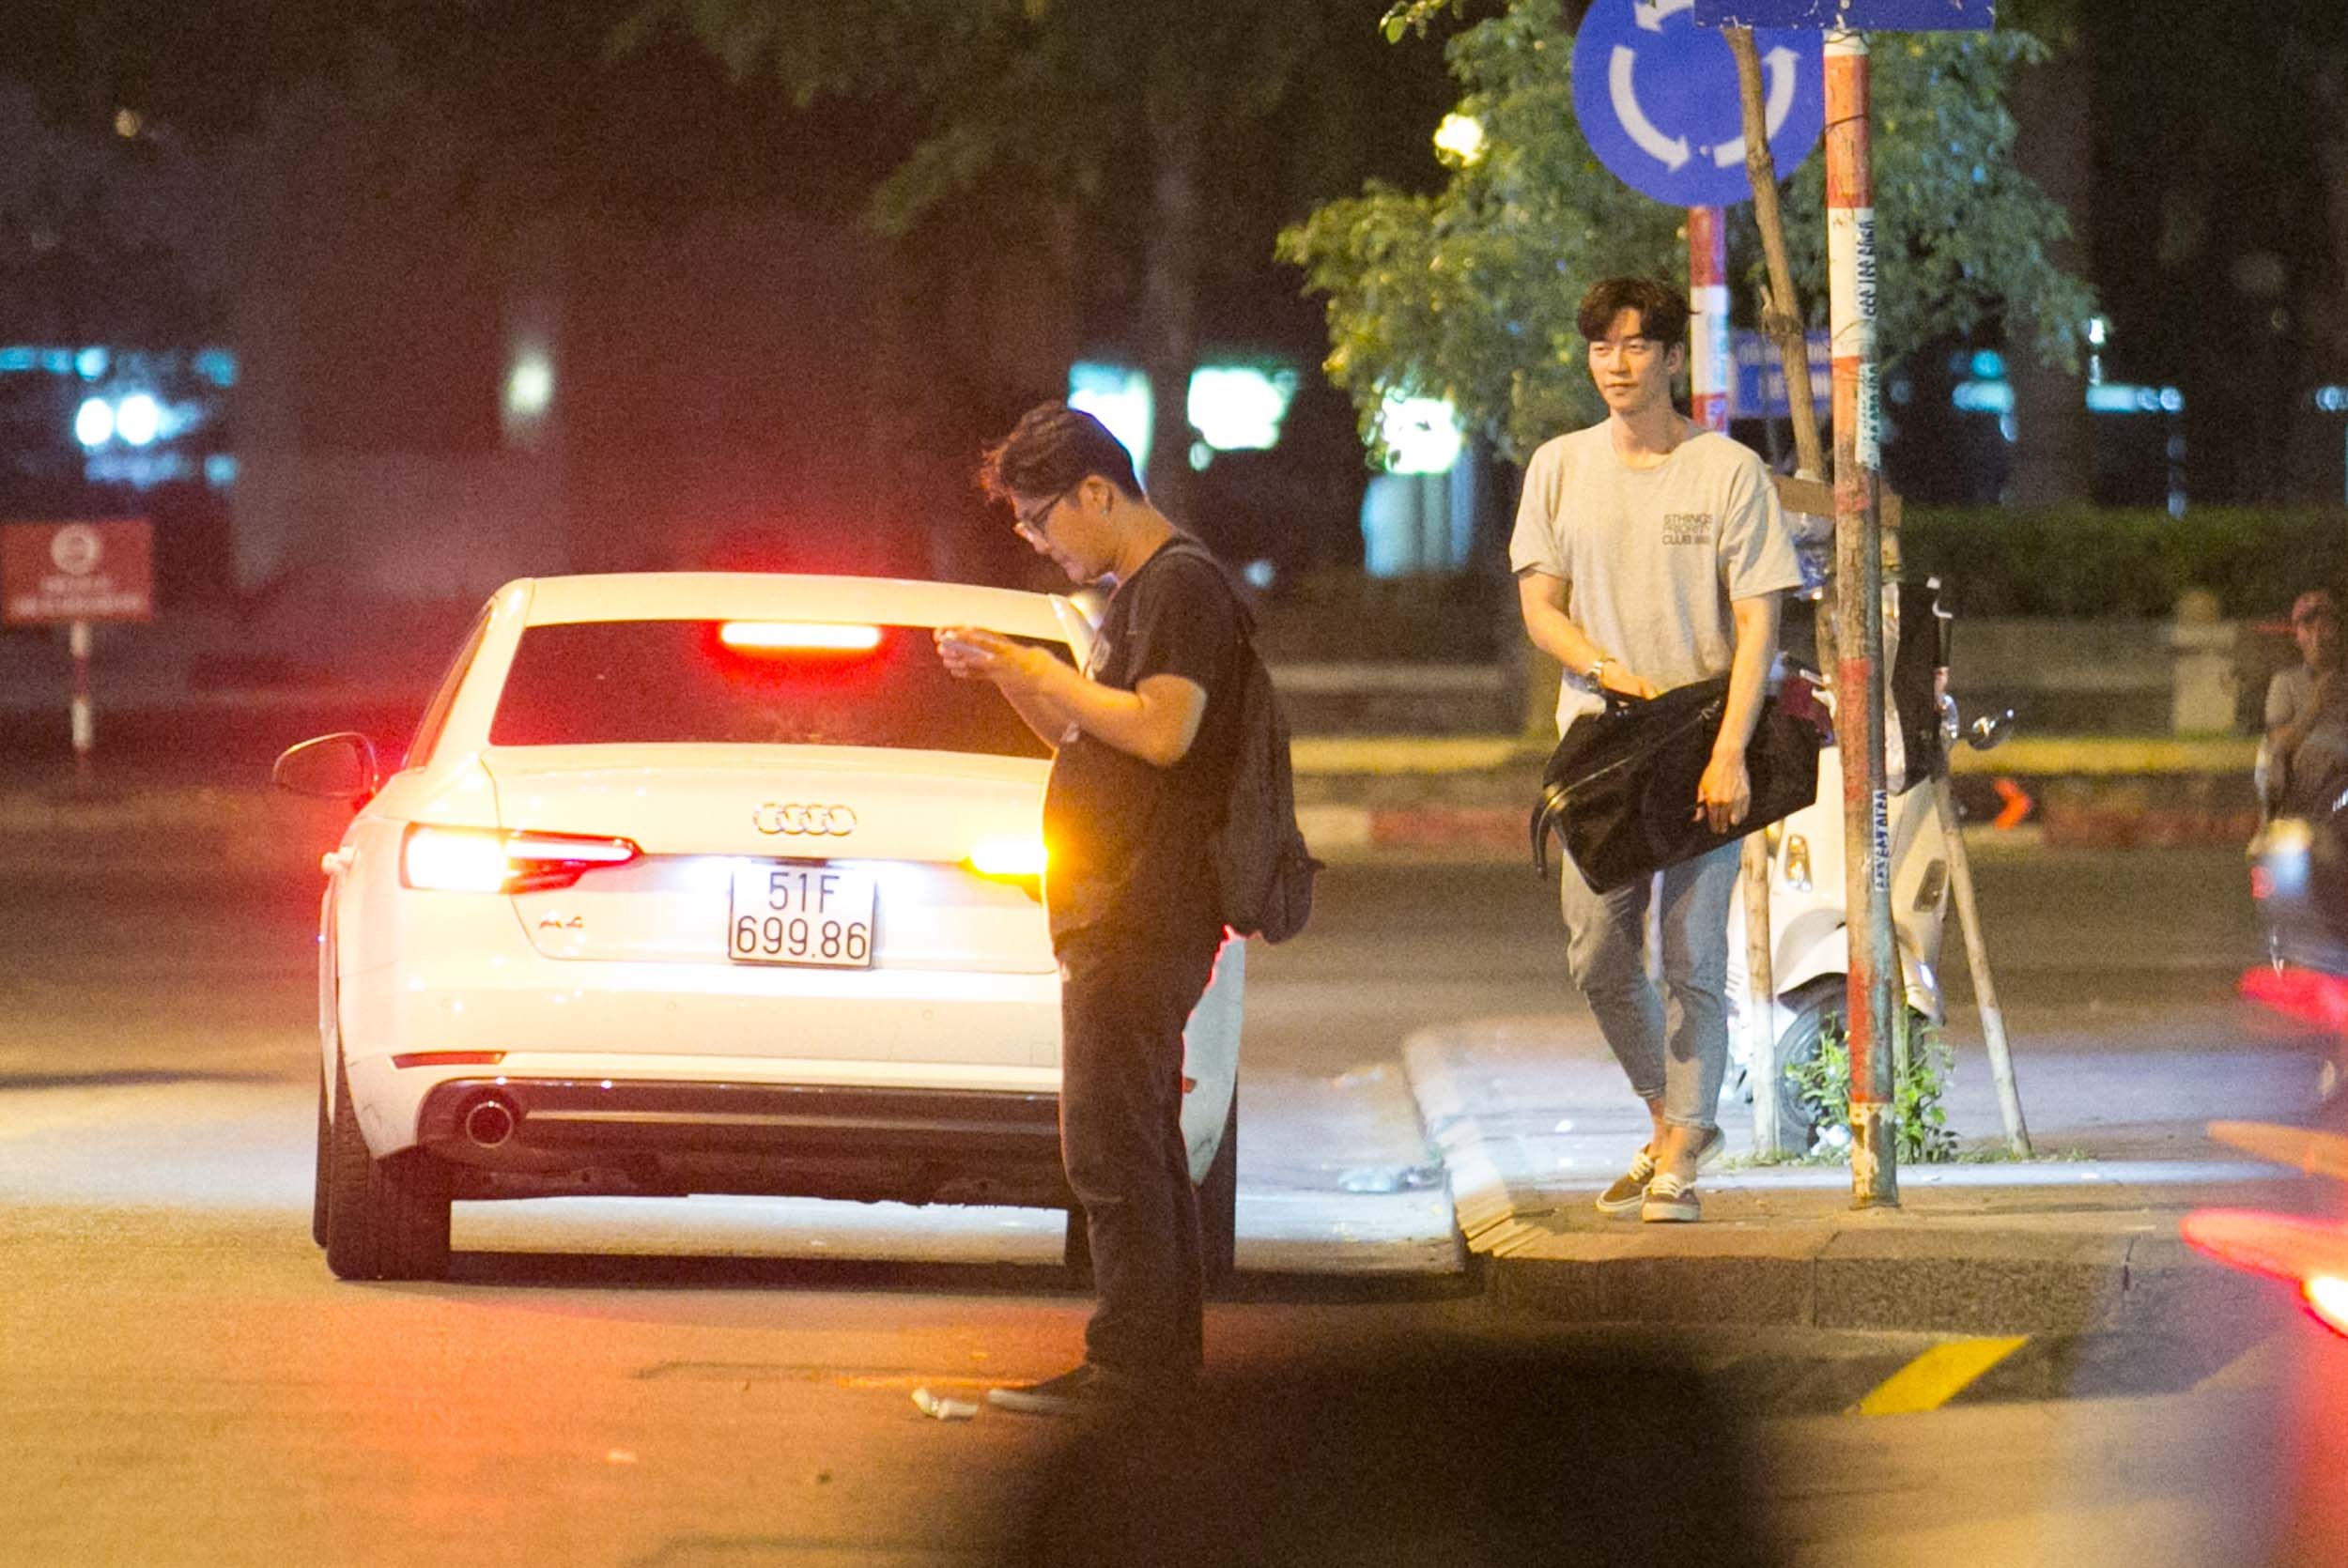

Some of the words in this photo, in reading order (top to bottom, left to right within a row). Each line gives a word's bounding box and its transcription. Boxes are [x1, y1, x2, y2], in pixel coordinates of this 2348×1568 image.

[1661, 534, 1691, 545] CLUB
[768, 872, 840, 913] 51F
[736, 915, 867, 960] 699.86
